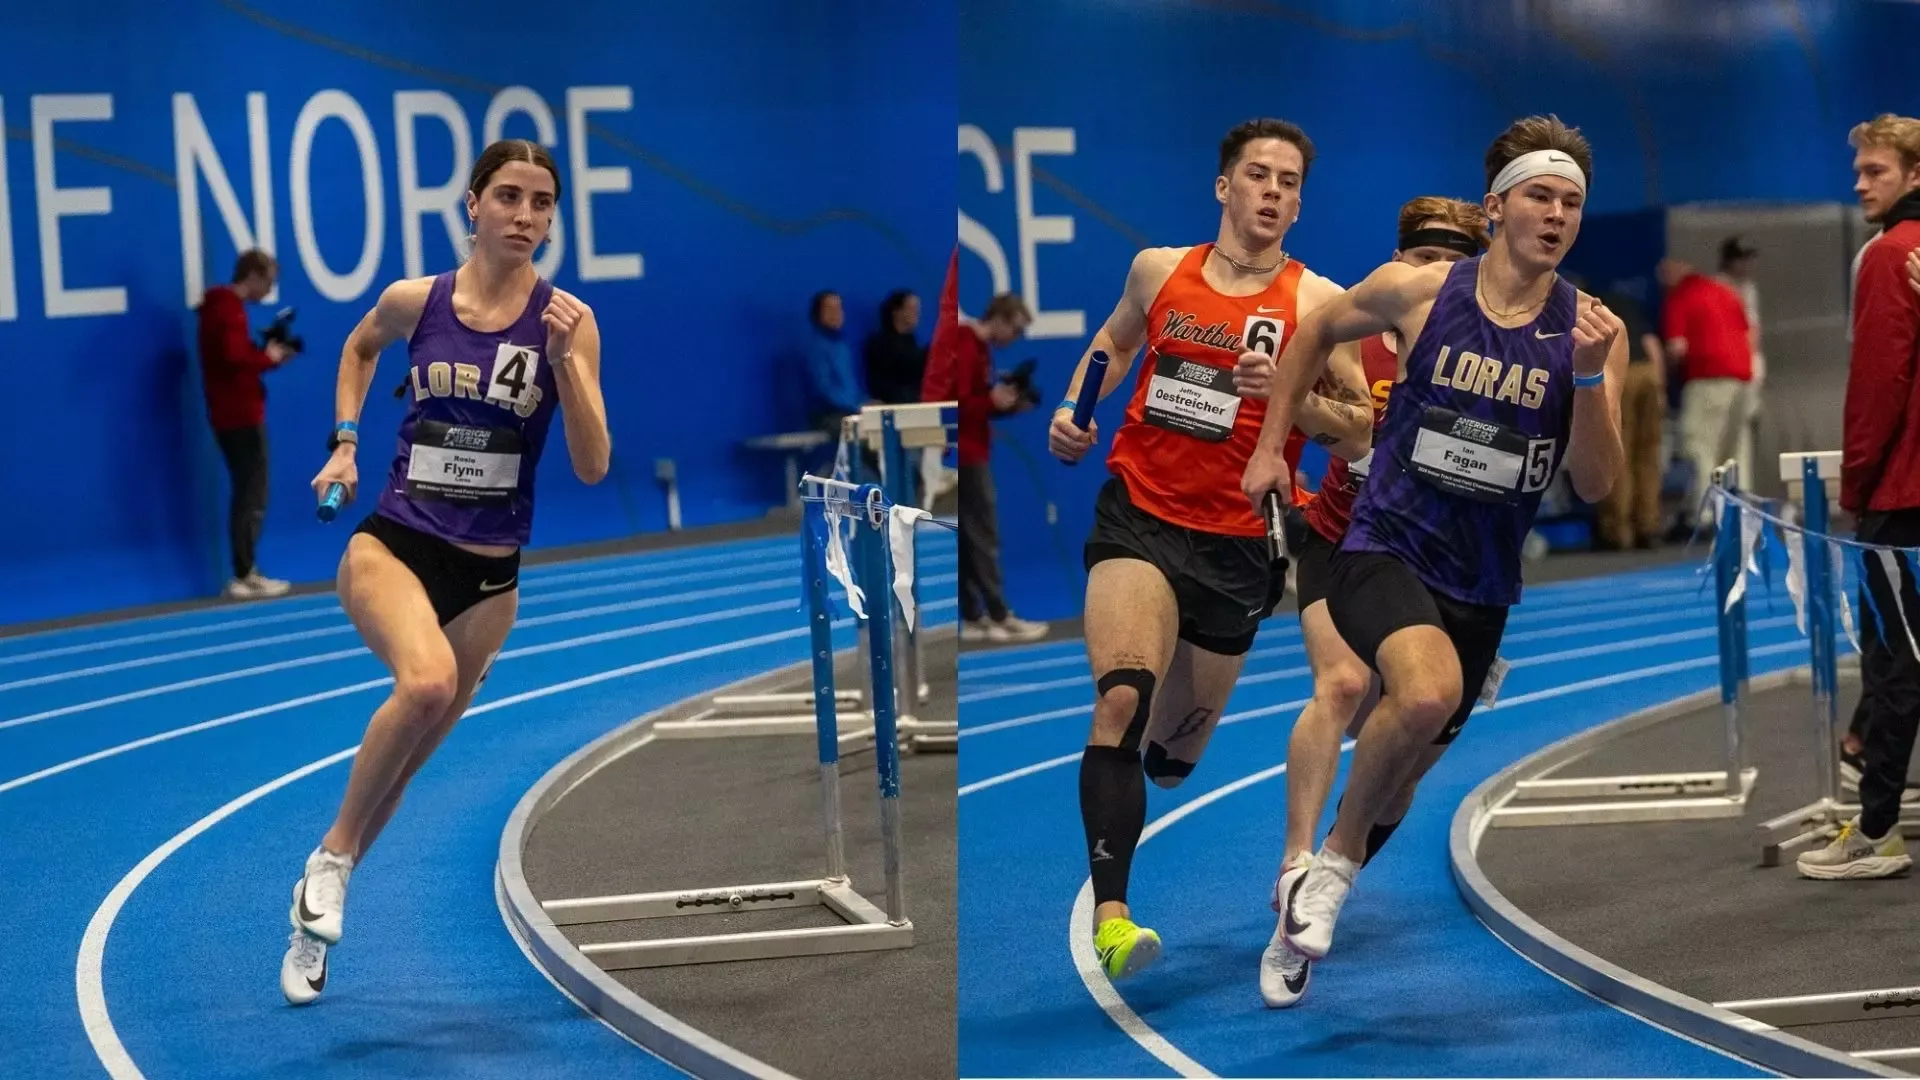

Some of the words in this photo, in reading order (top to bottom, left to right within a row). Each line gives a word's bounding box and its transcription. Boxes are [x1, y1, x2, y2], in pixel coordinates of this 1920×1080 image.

[1159, 309, 1243, 351] Wartbu
[1246, 320, 1277, 358] 6
[496, 350, 529, 398] 4
[1180, 361, 1219, 376] AMERICAN
[1431, 345, 1550, 410] LORAS
[410, 361, 543, 418] LORS
[1179, 387, 1202, 398] Jeffrey
[1155, 388, 1226, 416] Oestreicher
[447, 427, 493, 438] AMERICAN
[1455, 417, 1500, 434] AMERICAN
[453, 455, 476, 464] Rosie
[1443, 449, 1488, 472] Fagan
[1462, 446, 1475, 455] Ian
[443, 463, 484, 477] Flynn
[1528, 442, 1553, 488] 5
